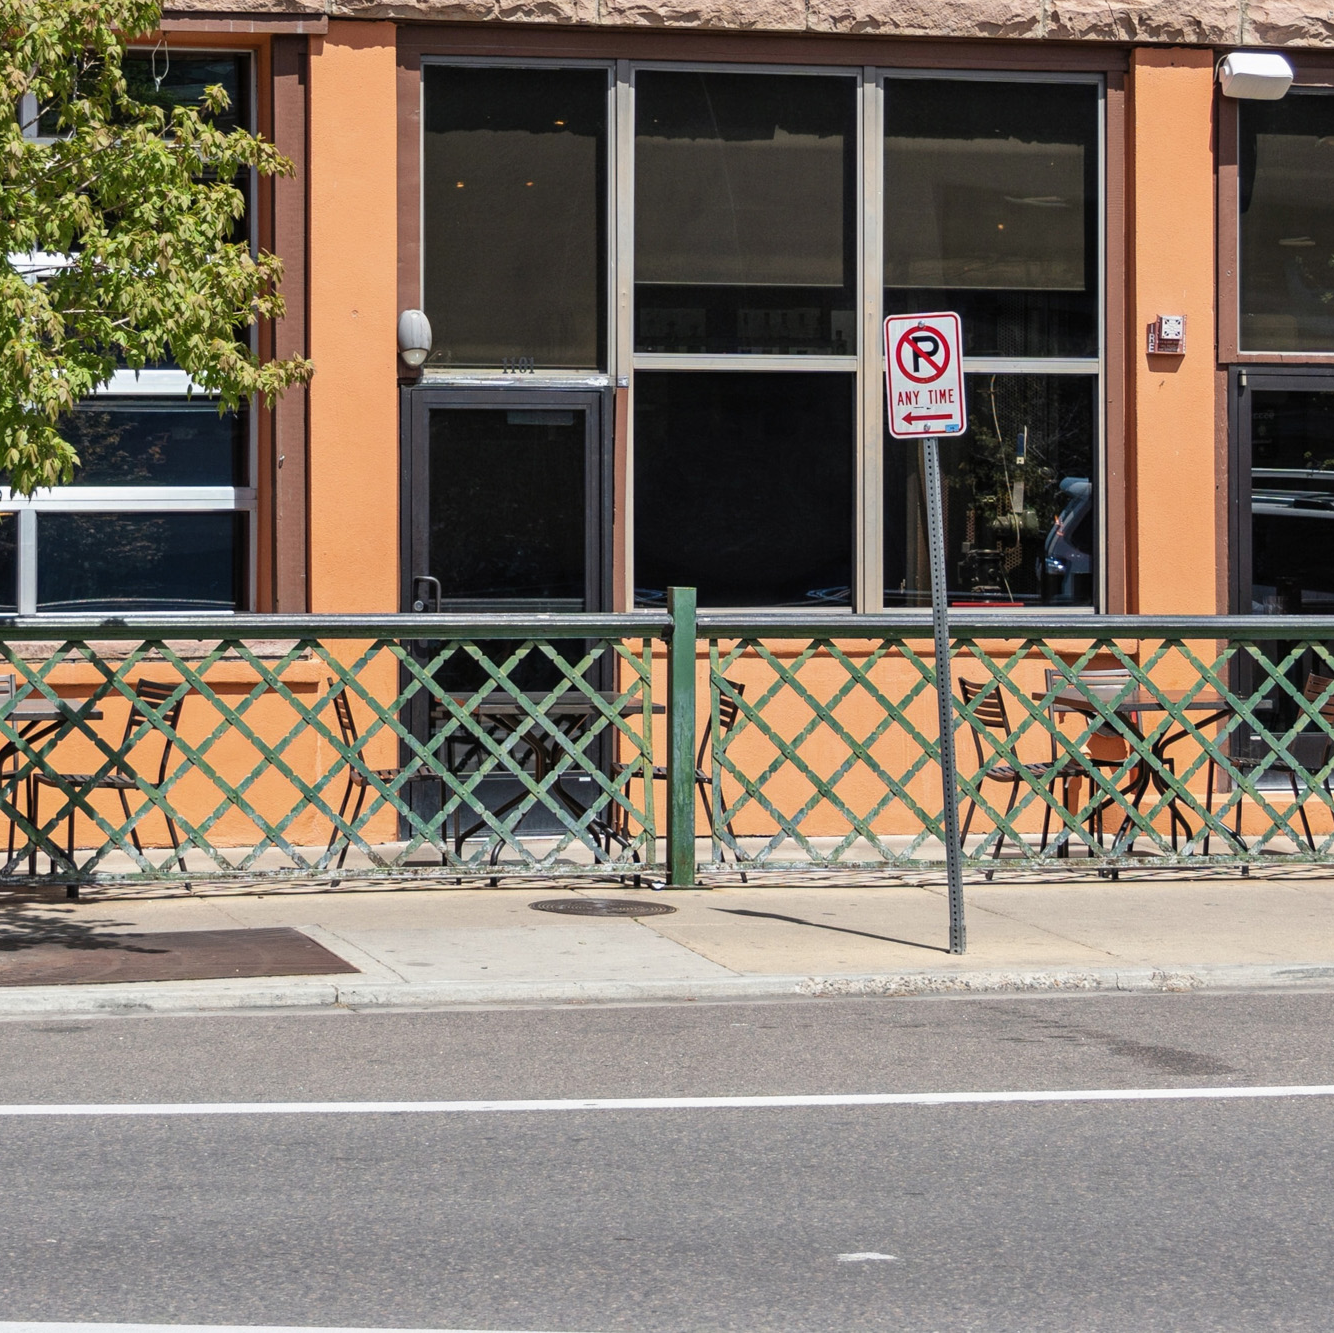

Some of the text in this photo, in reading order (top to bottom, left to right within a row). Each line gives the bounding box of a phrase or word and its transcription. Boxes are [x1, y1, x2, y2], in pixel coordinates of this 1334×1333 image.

[502, 357, 535, 374] 1101
[897, 389, 955, 406] ANY TIME
